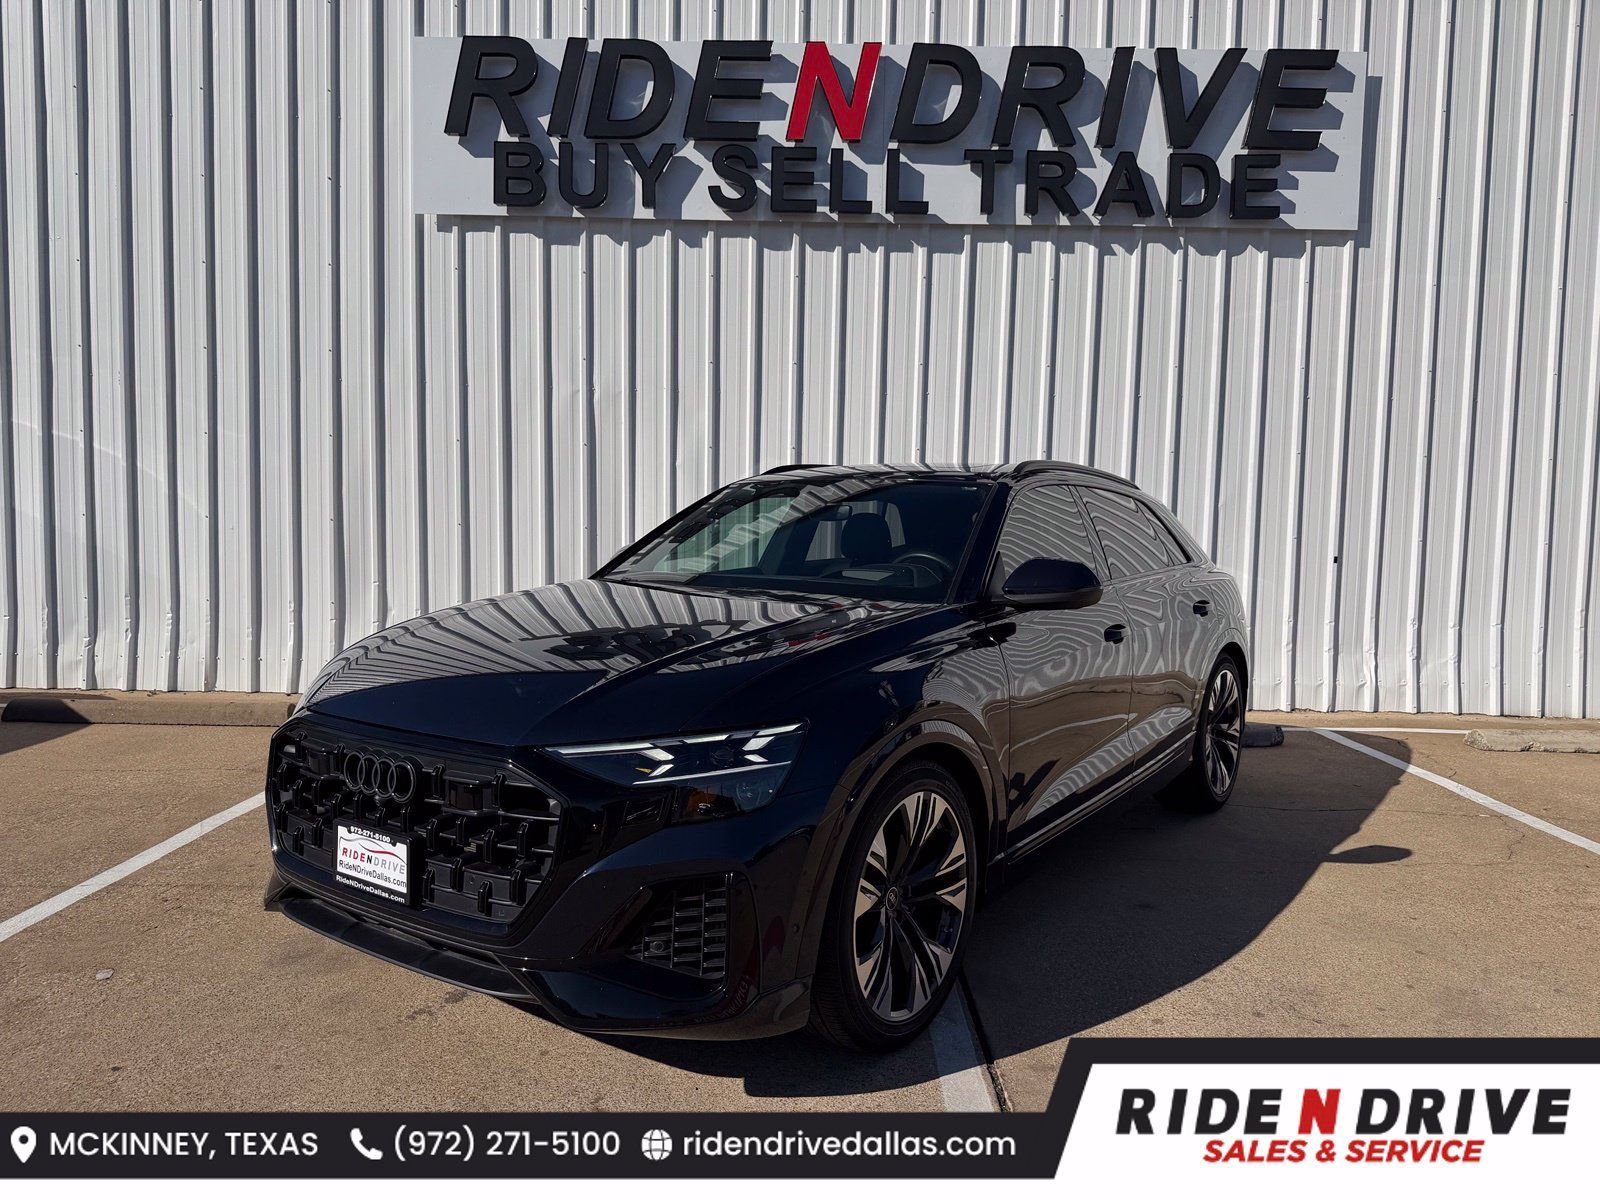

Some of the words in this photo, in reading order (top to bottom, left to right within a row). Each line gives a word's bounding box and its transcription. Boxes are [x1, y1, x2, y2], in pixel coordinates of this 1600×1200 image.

[493, 141, 676, 209] BUY
[708, 144, 929, 214] SELL
[964, 149, 1282, 219] TRADE
[339, 859, 406, 888] RideNDriveDallas.com
[342, 847, 405, 875] RIDENDRIVE
[336, 875, 405, 903] RideNDriveDallas.com
